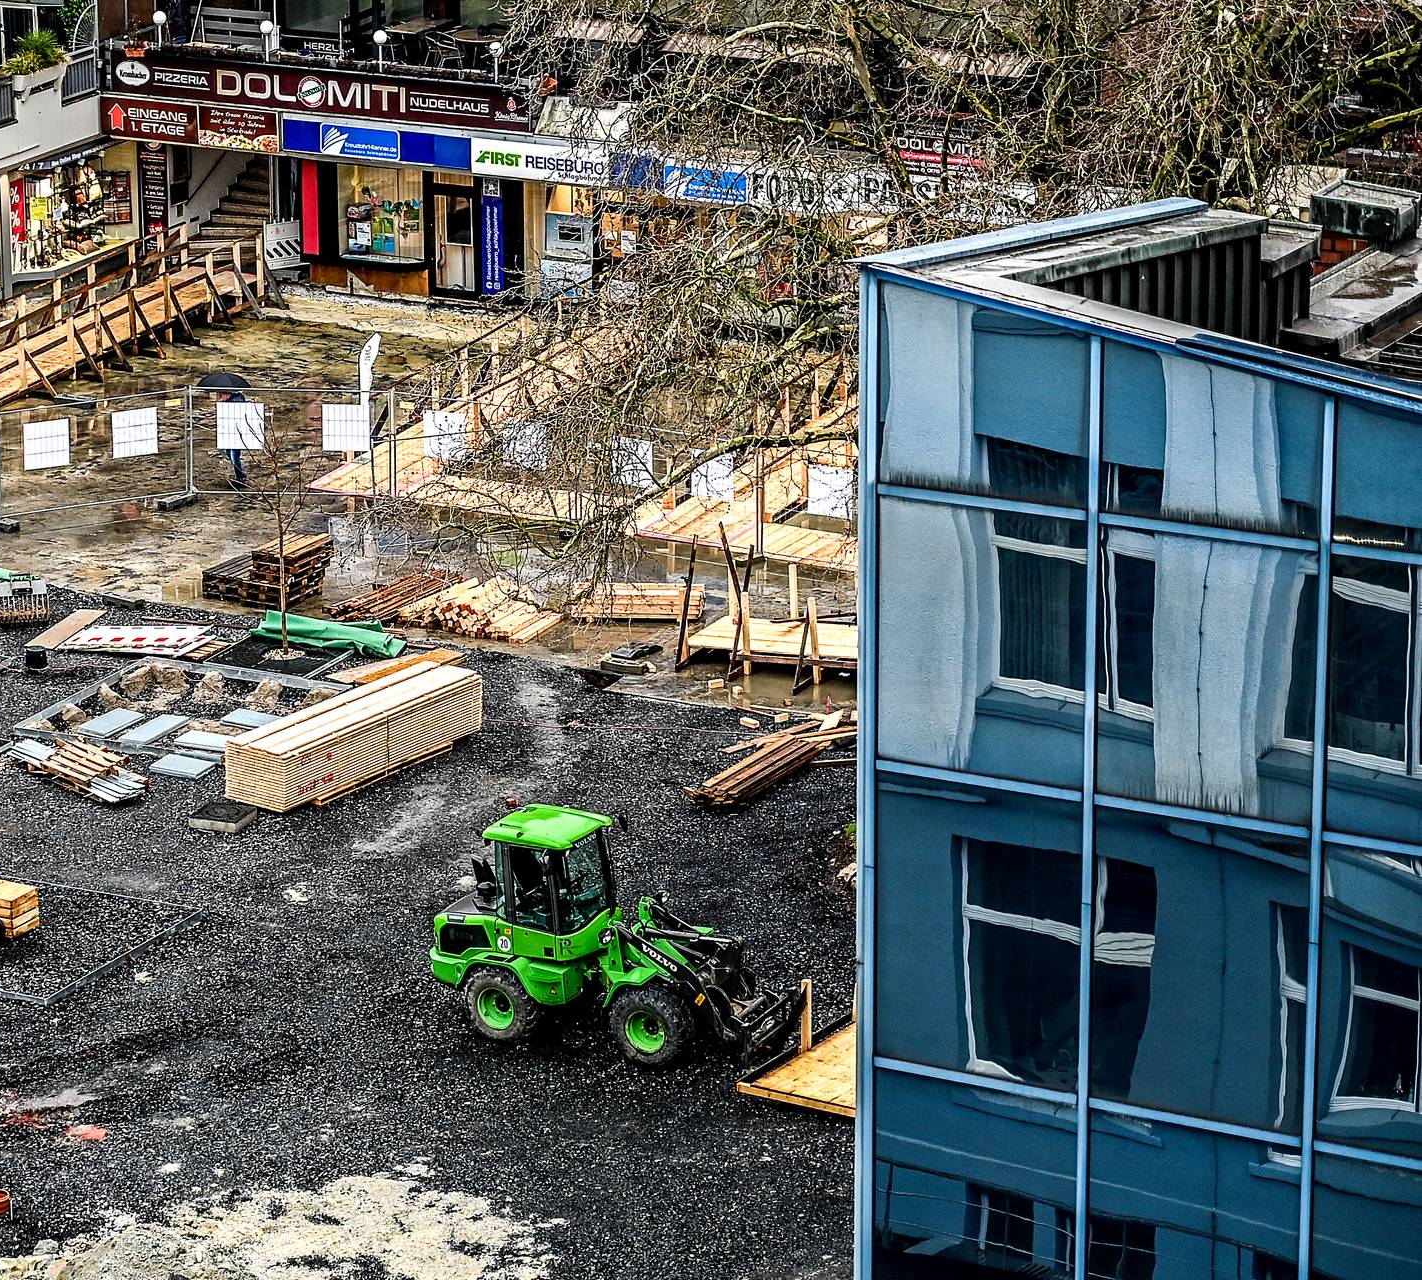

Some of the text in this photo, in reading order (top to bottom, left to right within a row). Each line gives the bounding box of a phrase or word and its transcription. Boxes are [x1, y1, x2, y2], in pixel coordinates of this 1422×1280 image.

[154, 72, 208, 86] PIZZERIA
[410, 98, 490, 114] NUDELHAUS
[127, 107, 188, 123] EINGANG
[130, 121, 186, 137] 1. ETAGE
[475, 150, 604, 176] FIRST REISEBÜRO
[574, 834, 597, 849] VOLVO
[500, 939, 509, 949] 20
[641, 943, 678, 973] VOLVO
